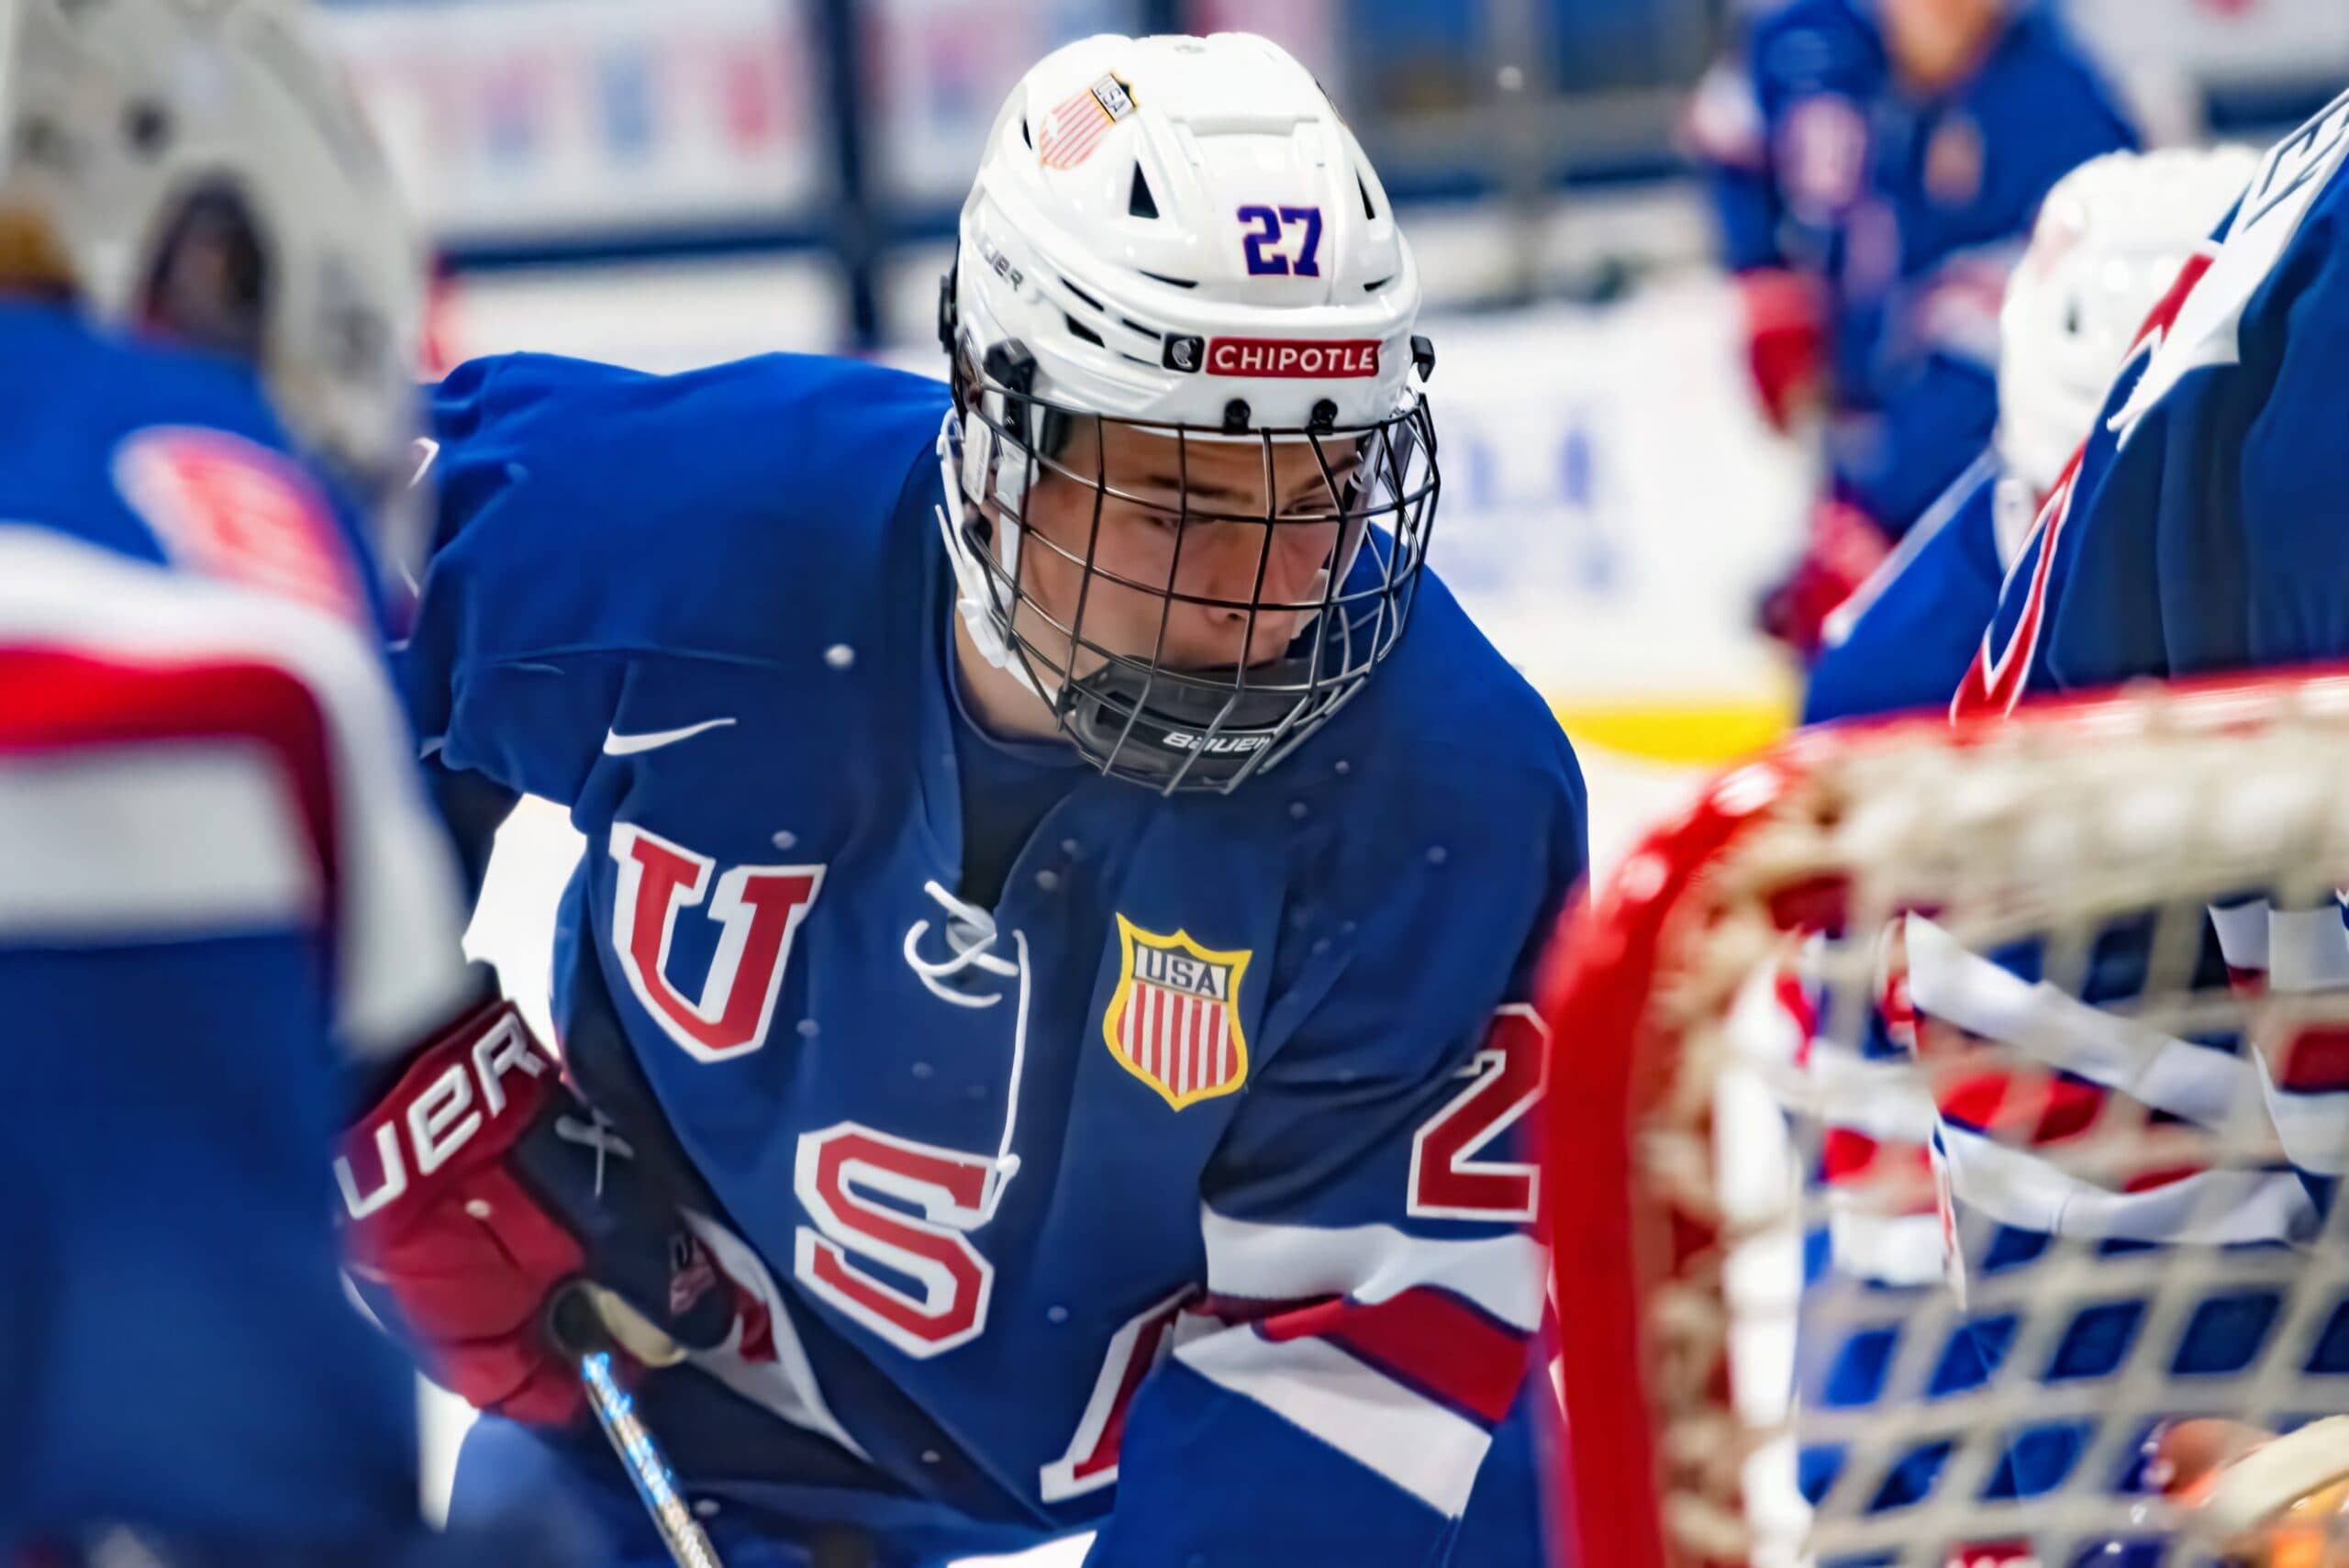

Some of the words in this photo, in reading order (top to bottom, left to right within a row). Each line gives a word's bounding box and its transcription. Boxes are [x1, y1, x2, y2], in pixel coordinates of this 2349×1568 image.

[1236, 205, 1322, 277] 27
[1215, 345, 1375, 373] CHIPOTLE
[1145, 947, 1218, 996] USA
